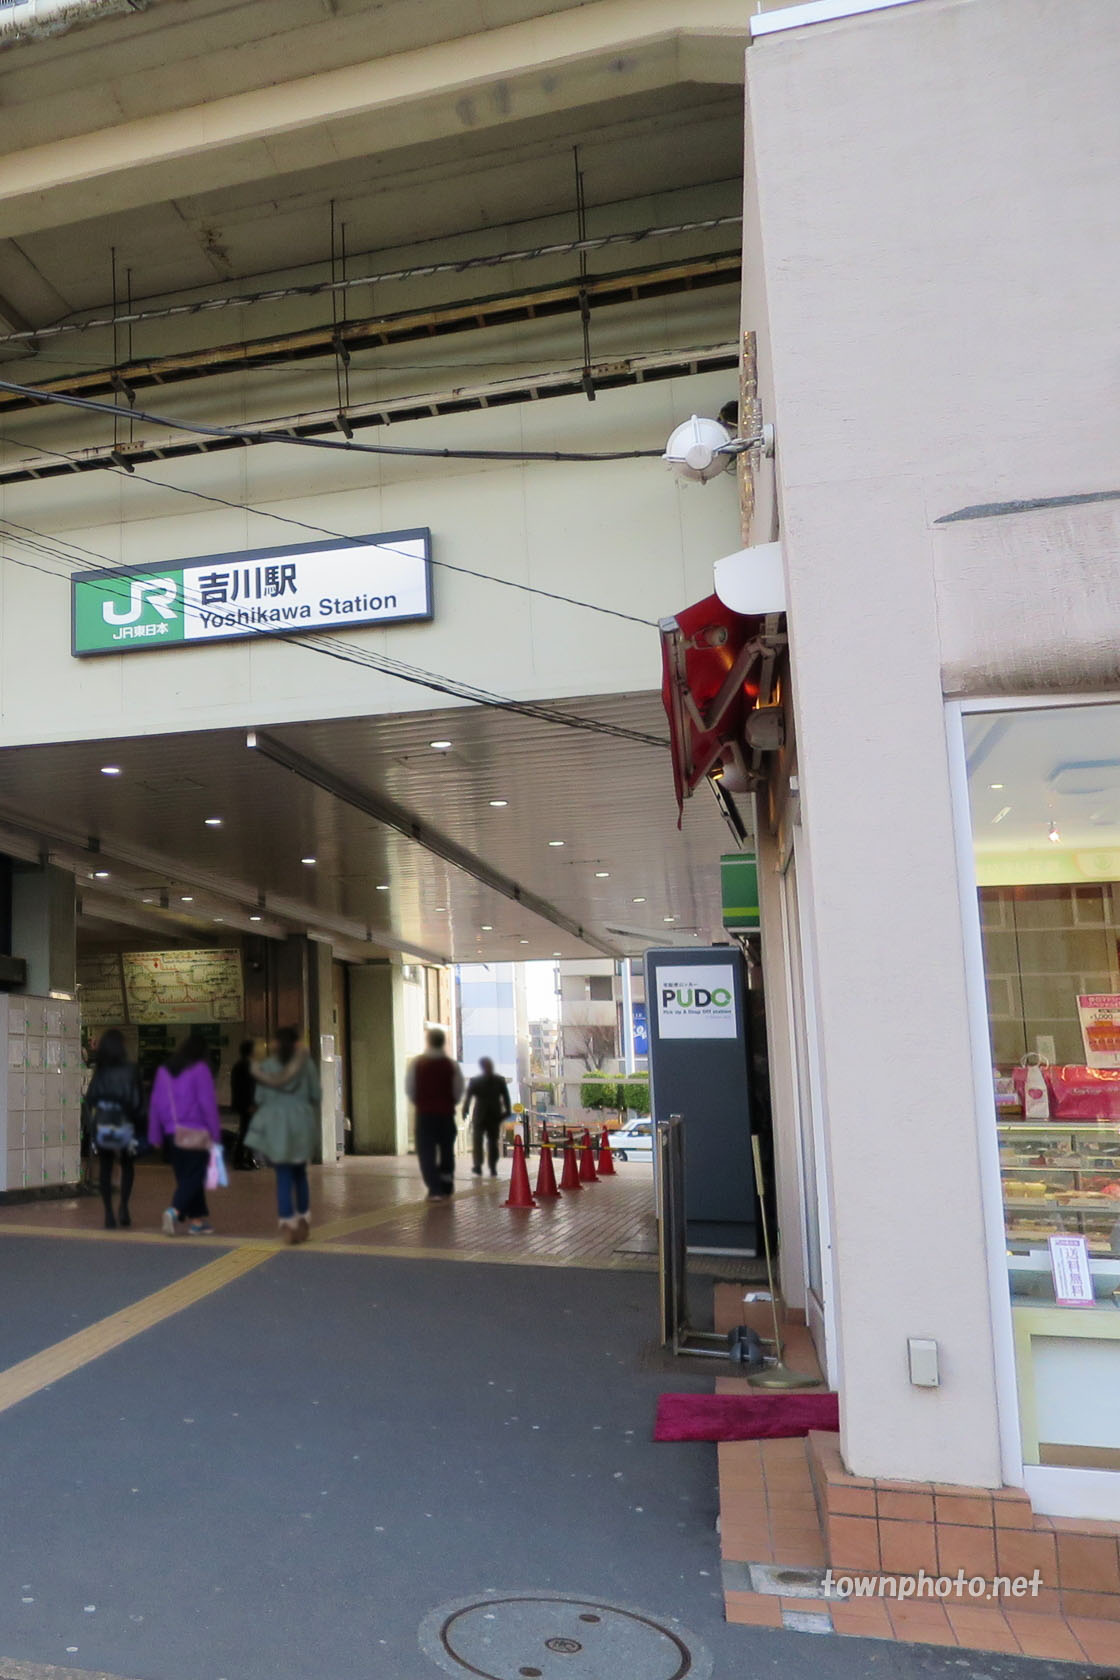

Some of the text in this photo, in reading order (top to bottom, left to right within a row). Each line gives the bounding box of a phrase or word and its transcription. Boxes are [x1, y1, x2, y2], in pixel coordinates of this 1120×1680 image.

[103, 578, 178, 625] JR
[198, 564, 297, 606] 吉川駅
[199, 594, 397, 629] Yoshikawa Station
[112, 622, 168, 640] JR東日本
[662, 988, 732, 1008] PUDO
